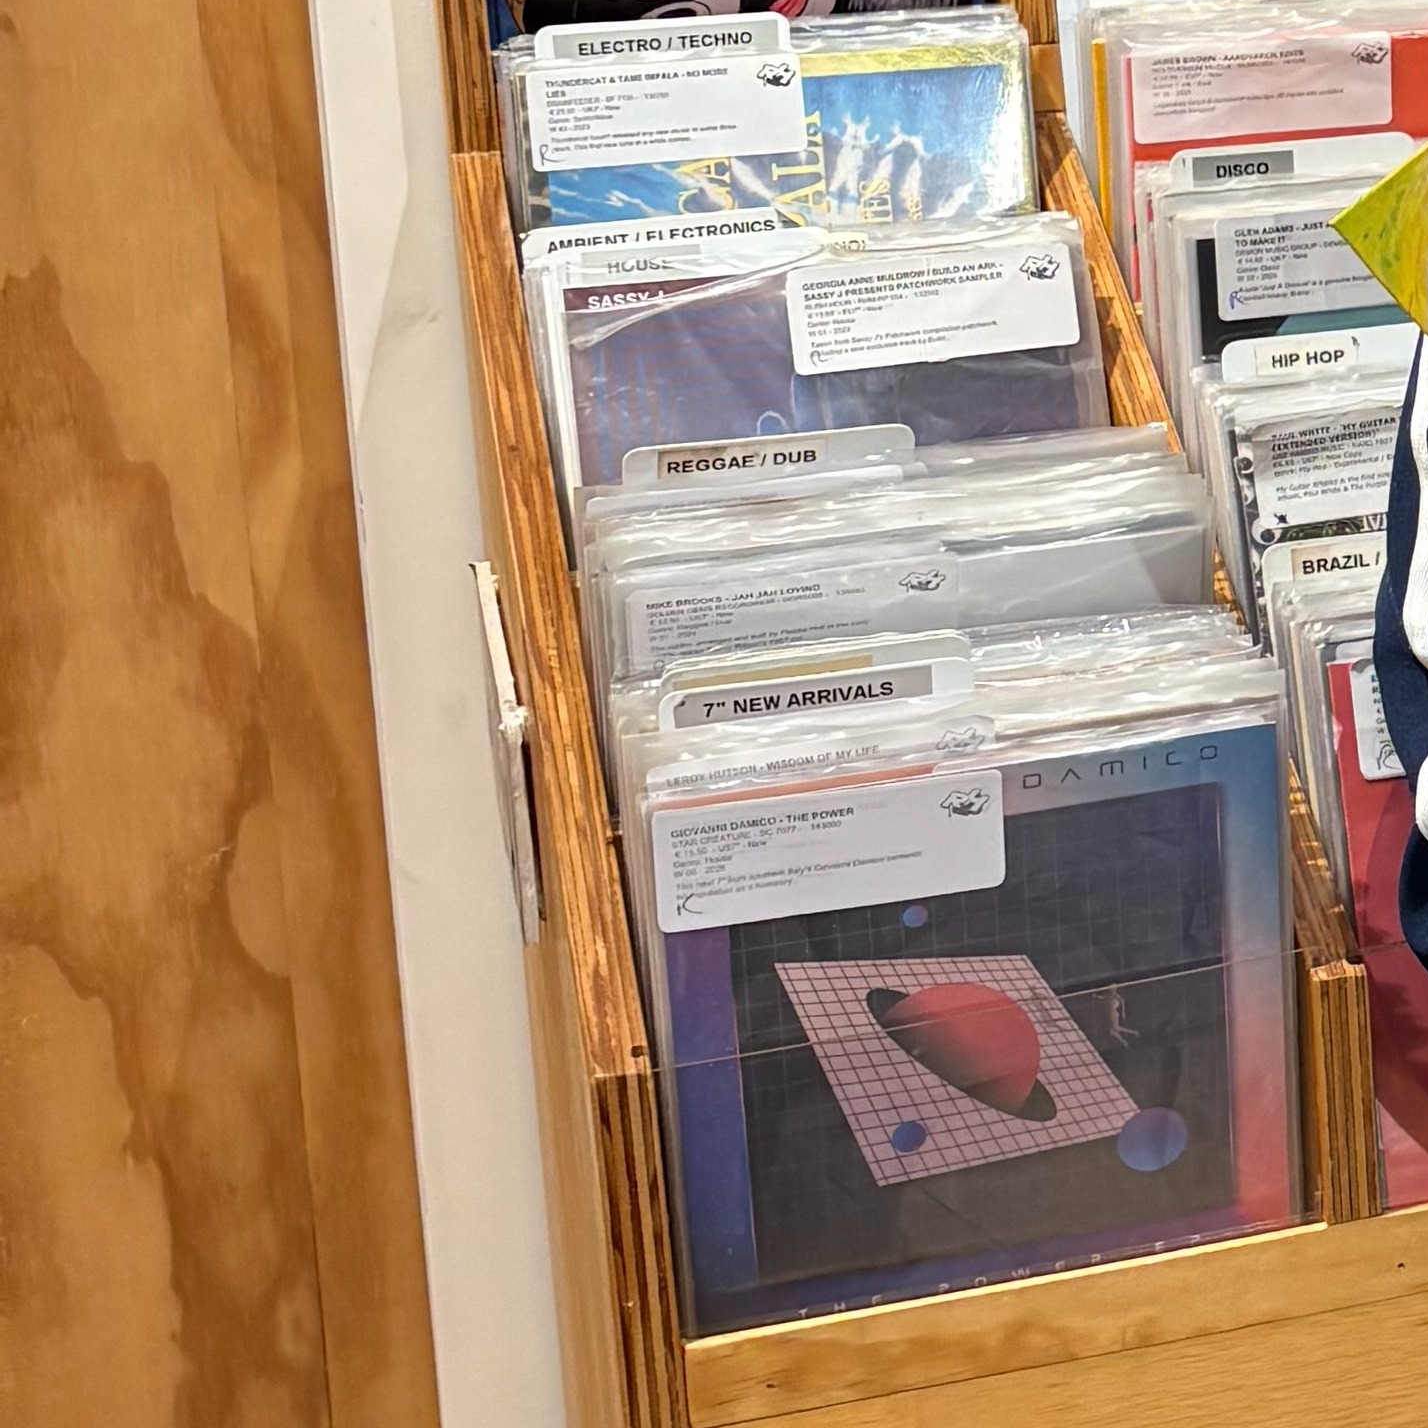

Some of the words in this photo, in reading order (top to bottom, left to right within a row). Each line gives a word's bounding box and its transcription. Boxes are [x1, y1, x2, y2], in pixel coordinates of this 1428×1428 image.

[578, 38, 661, 56] ELECTRO
[677, 31, 753, 49] TECHNO
[1216, 162, 1269, 178] DISCO
[1234, 228, 1260, 238] GLEN
[1262, 225, 1294, 235] ADAMS
[1301, 222, 1324, 231] JUST
[1235, 239, 1248, 247] TO
[803, 279, 846, 291] GEORGIA
[962, 264, 975, 272] AN
[804, 291, 836, 302] SASSY
[845, 284, 895, 297] PRESENTS
[896, 276, 957, 290] PATCHWORK
[958, 271, 1003, 284] SAMPLER
[1272, 353, 1301, 369] HIP
[1306, 350, 1346, 366] HOP
[666, 450, 757, 475] REGGAE
[760, 450, 768, 468] /
[772, 447, 818, 466] DUB
[1302, 553, 1370, 575] BRAZIL
[702, 701, 726, 720] 7"
[733, 695, 782, 715] NEW
[786, 681, 894, 709] ARRIVALS
[836, 747, 853, 760] MY
[855, 745, 880, 757] LIFE
[671, 823, 729, 839] GIOVANNI
[730, 816, 777, 832] DAMICO
[786, 811, 810, 825] THE
[811, 806, 855, 821] POWER
